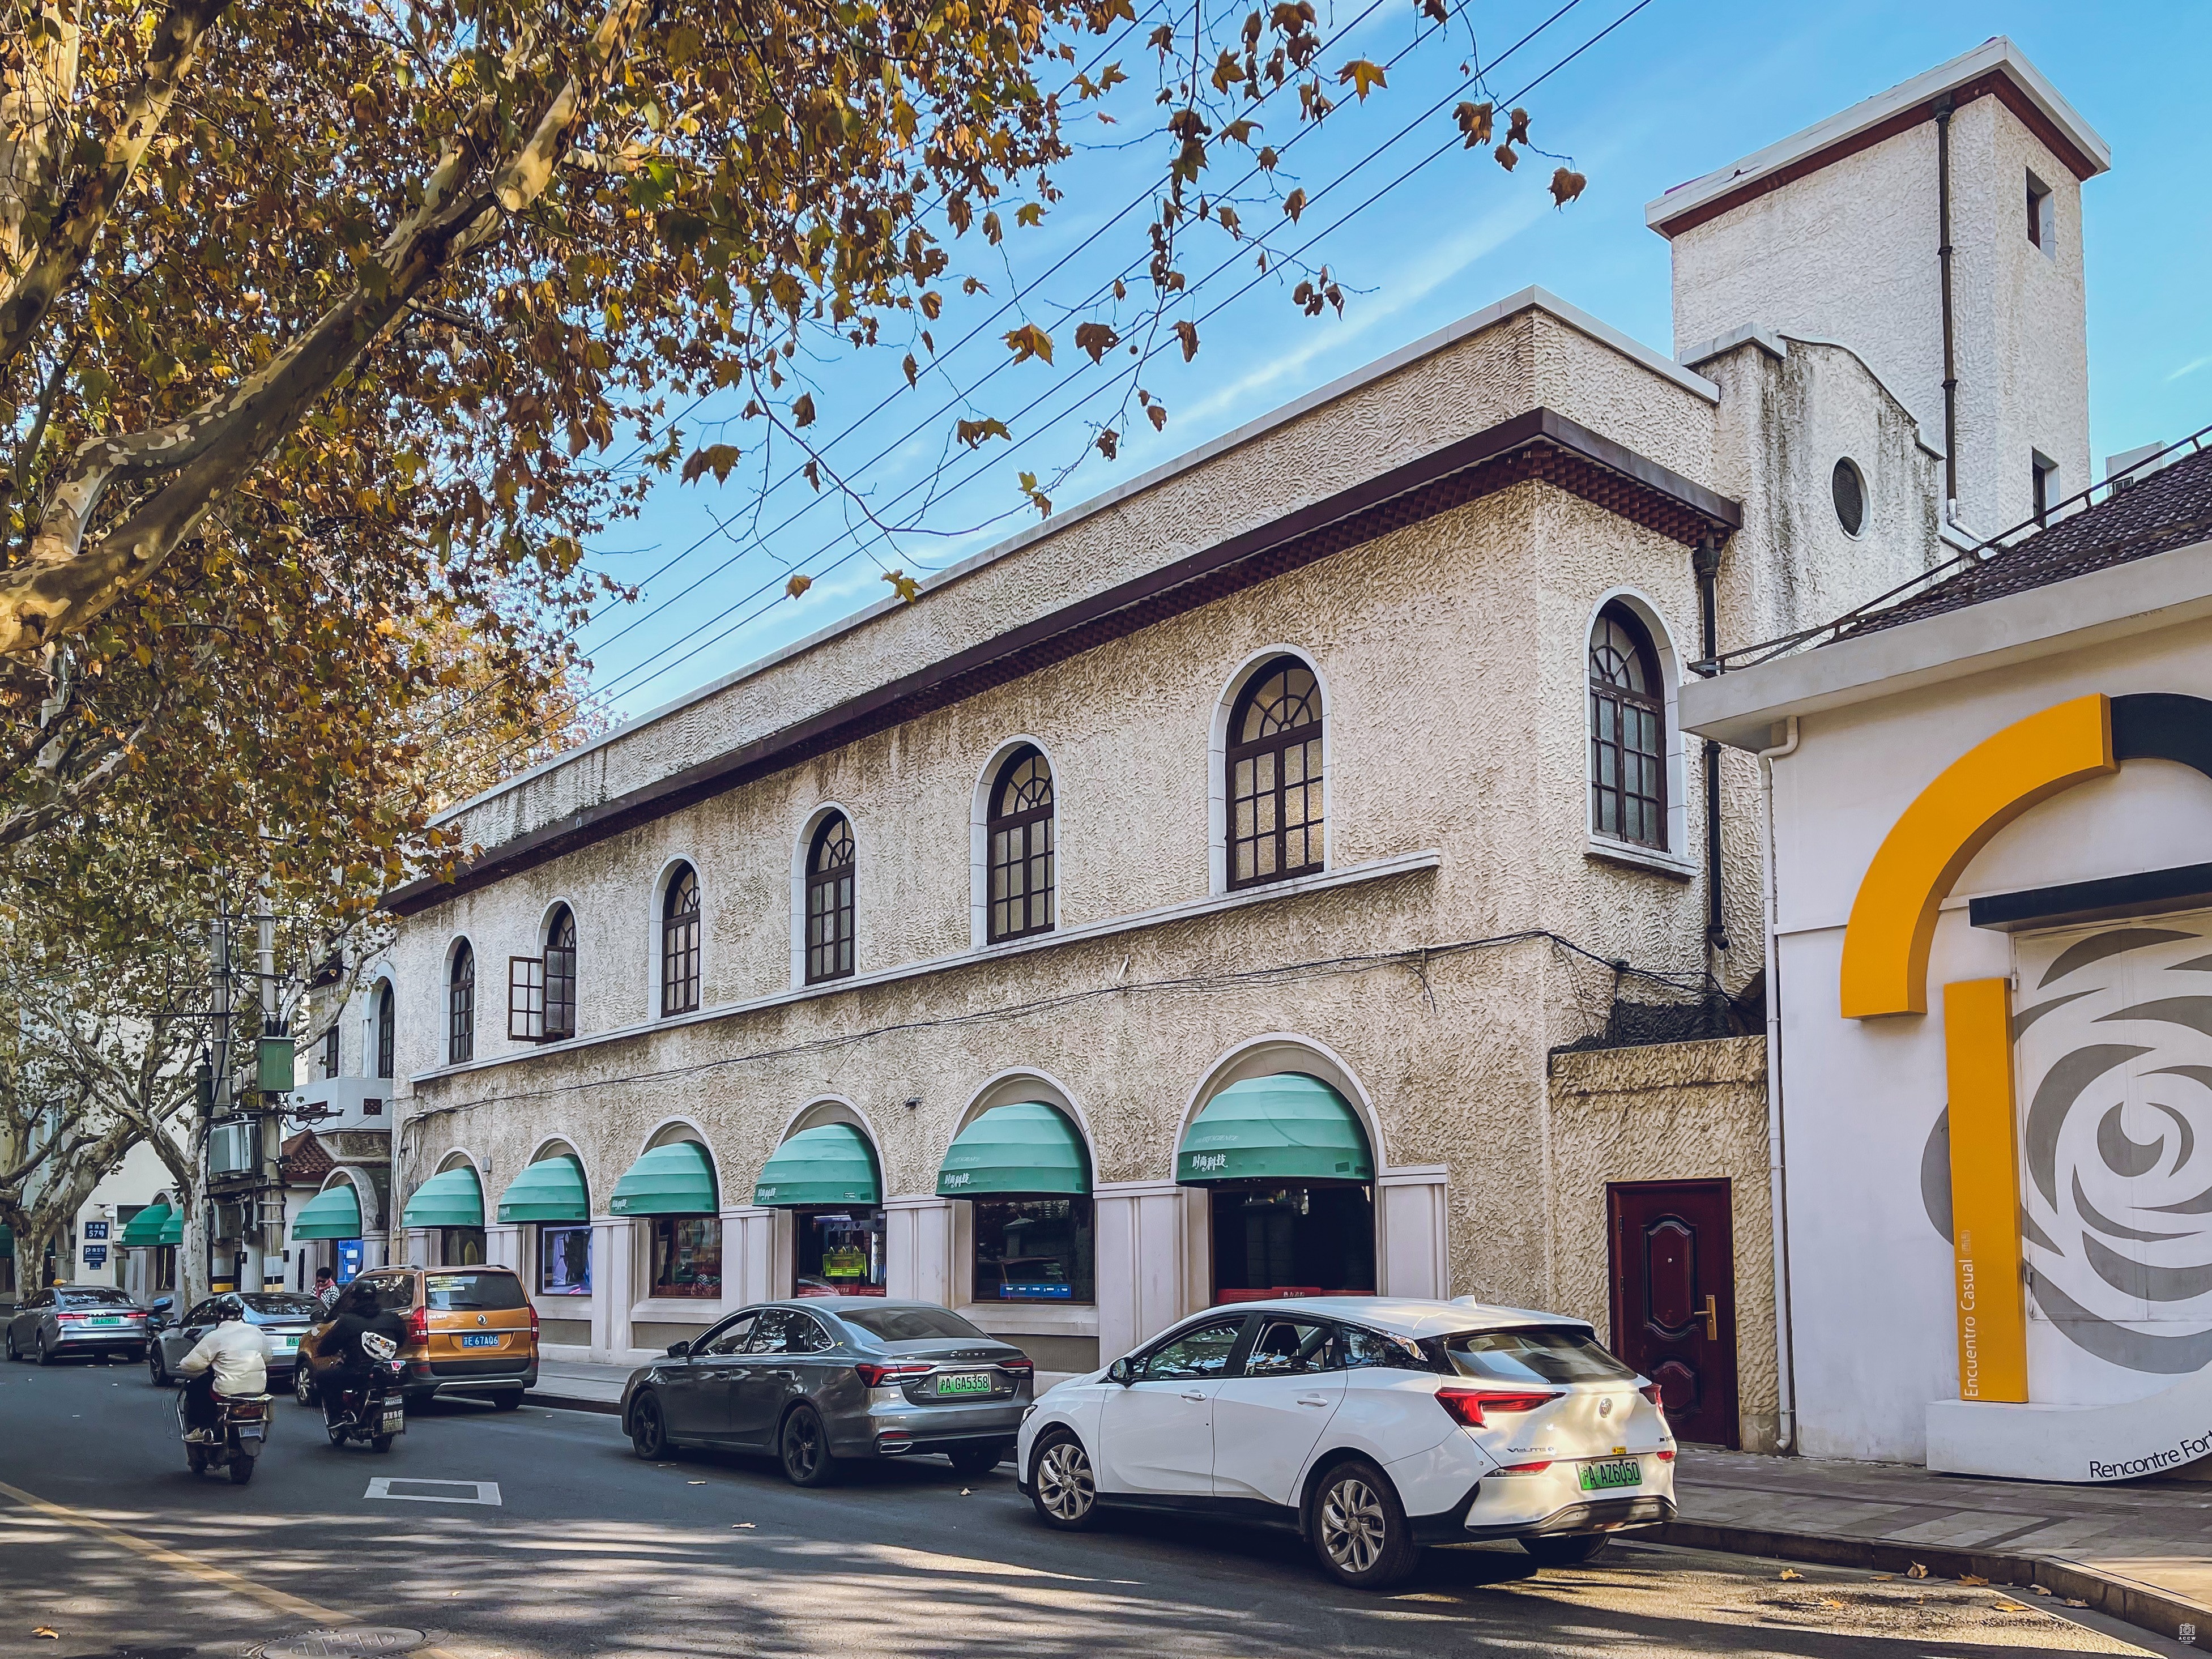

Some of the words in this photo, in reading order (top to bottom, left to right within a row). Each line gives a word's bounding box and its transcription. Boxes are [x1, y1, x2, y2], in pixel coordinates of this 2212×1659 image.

[1192, 1154, 1228, 1172] 时尚科技
[944, 1173, 971, 1188] 时尚科技
[1958, 1259, 1975, 1311] Casual
[1963, 1316, 1978, 1397] Encuentro
[955, 1376, 988, 1390] GA5358
[1600, 1462, 1640, 1485] AZ6050
[2089, 1449, 2181, 1478] Rencontre
